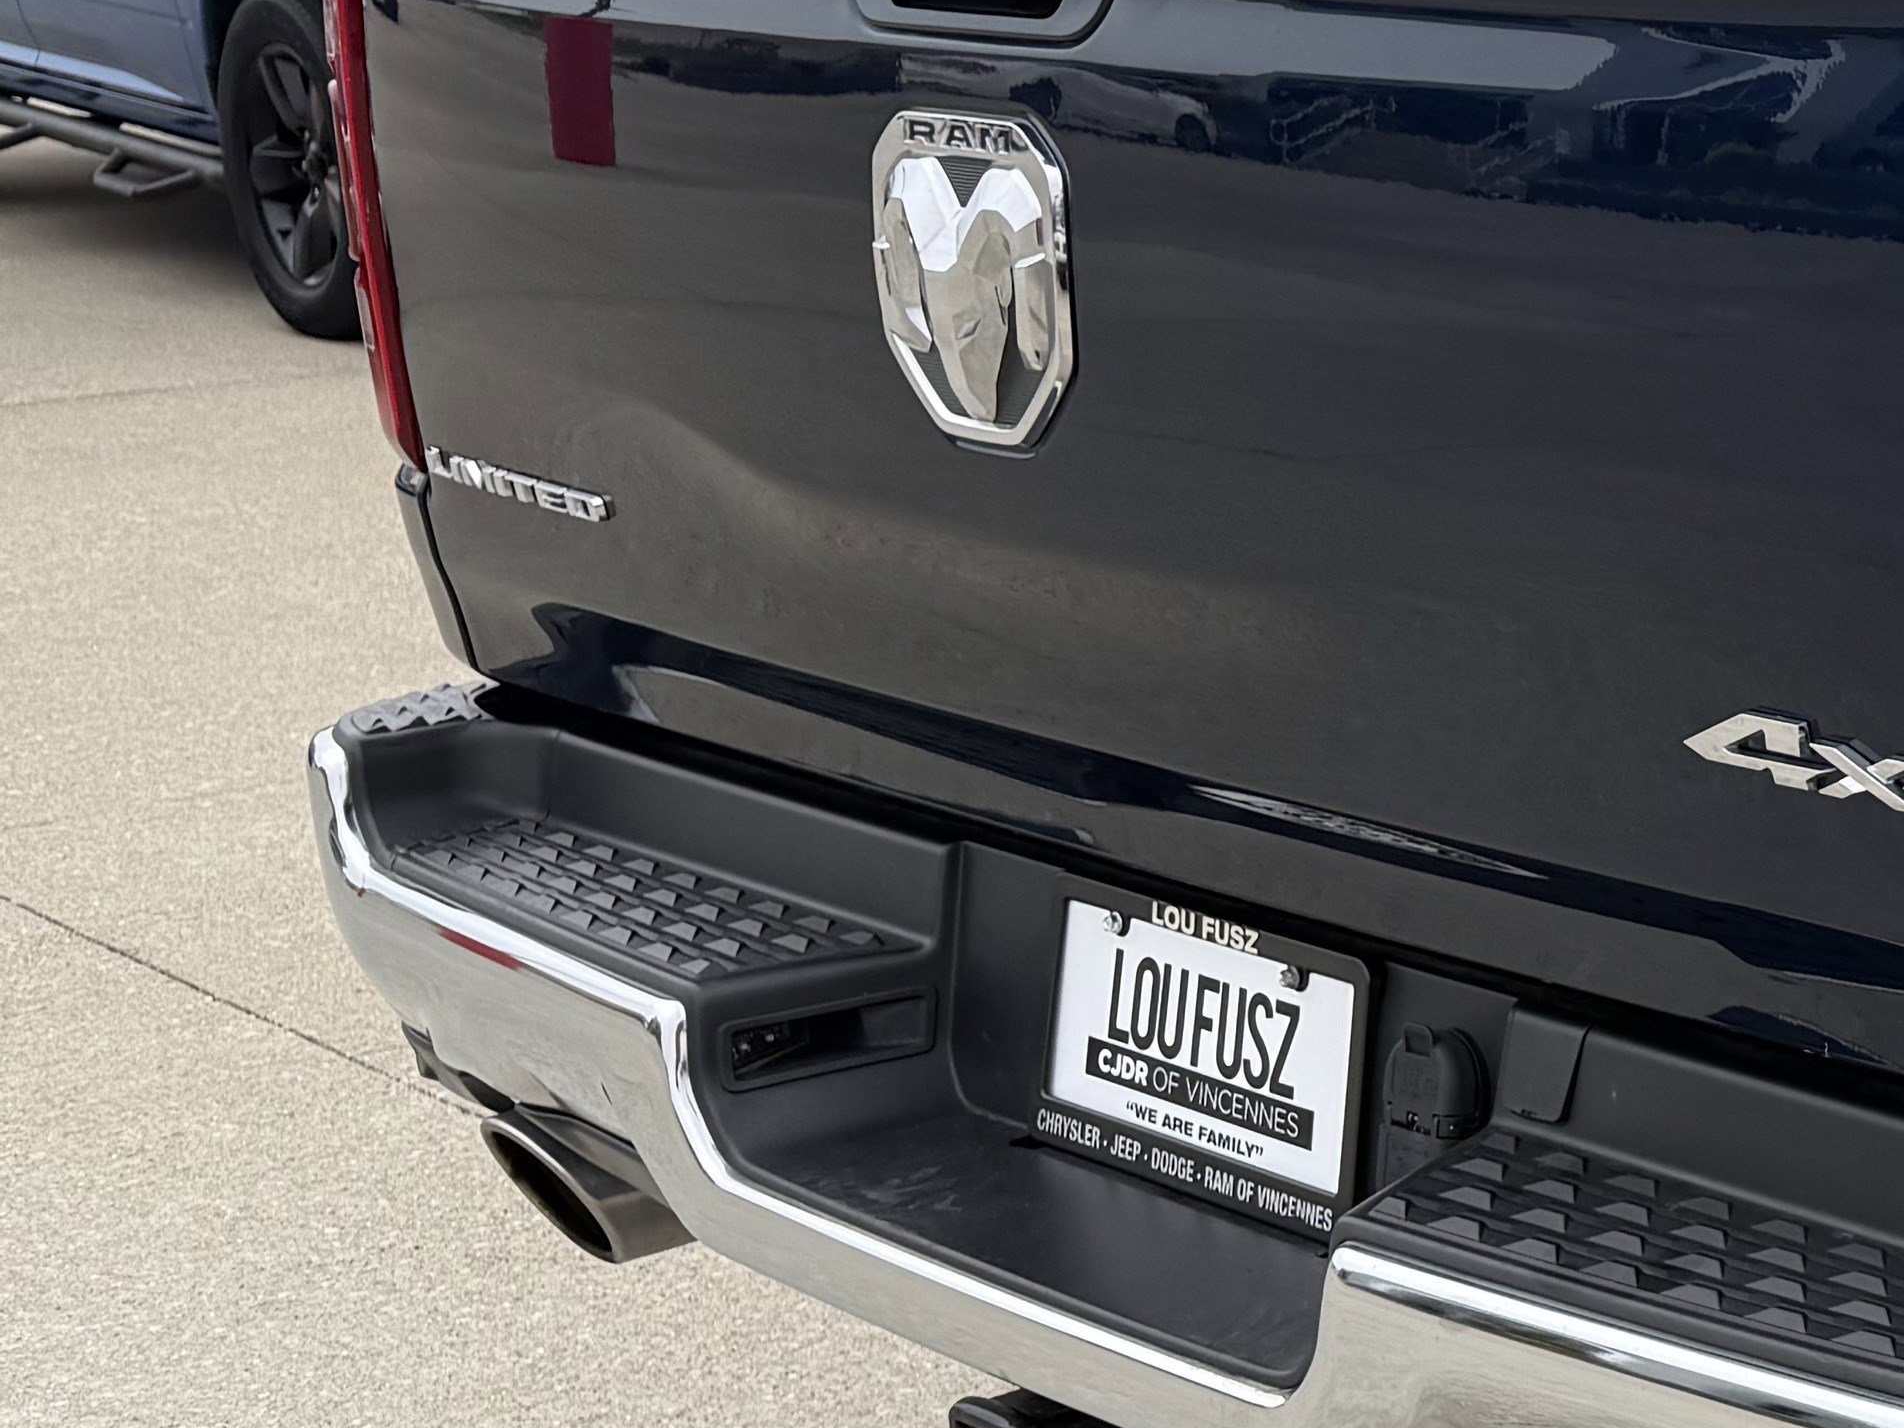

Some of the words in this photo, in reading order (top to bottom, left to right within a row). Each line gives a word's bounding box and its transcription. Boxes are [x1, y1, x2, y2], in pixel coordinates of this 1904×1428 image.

[903, 119, 1012, 155] RAM
[425, 445, 615, 522] LIMITED
[1151, 900, 1196, 937] LOU
[1201, 918, 1260, 955] FUSZ
[1107, 947, 1190, 1060] LOU
[1190, 973, 1301, 1101] FUSZ
[1097, 1050, 1150, 1087] CJDR
[1152, 1067, 1180, 1095] OF
[1185, 1076, 1300, 1140] VINCENNES
[1162, 1113, 1194, 1138] ARE
[1036, 1108, 1102, 1149] CHRYSLER
[1109, 1135, 1142, 1163] JEEP
[1151, 1147, 1195, 1183] DODGE
[1204, 1165, 1234, 1197] RAM
[1236, 1179, 1254, 1204] OF
[1257, 1187, 1334, 1233] VINCENNES
